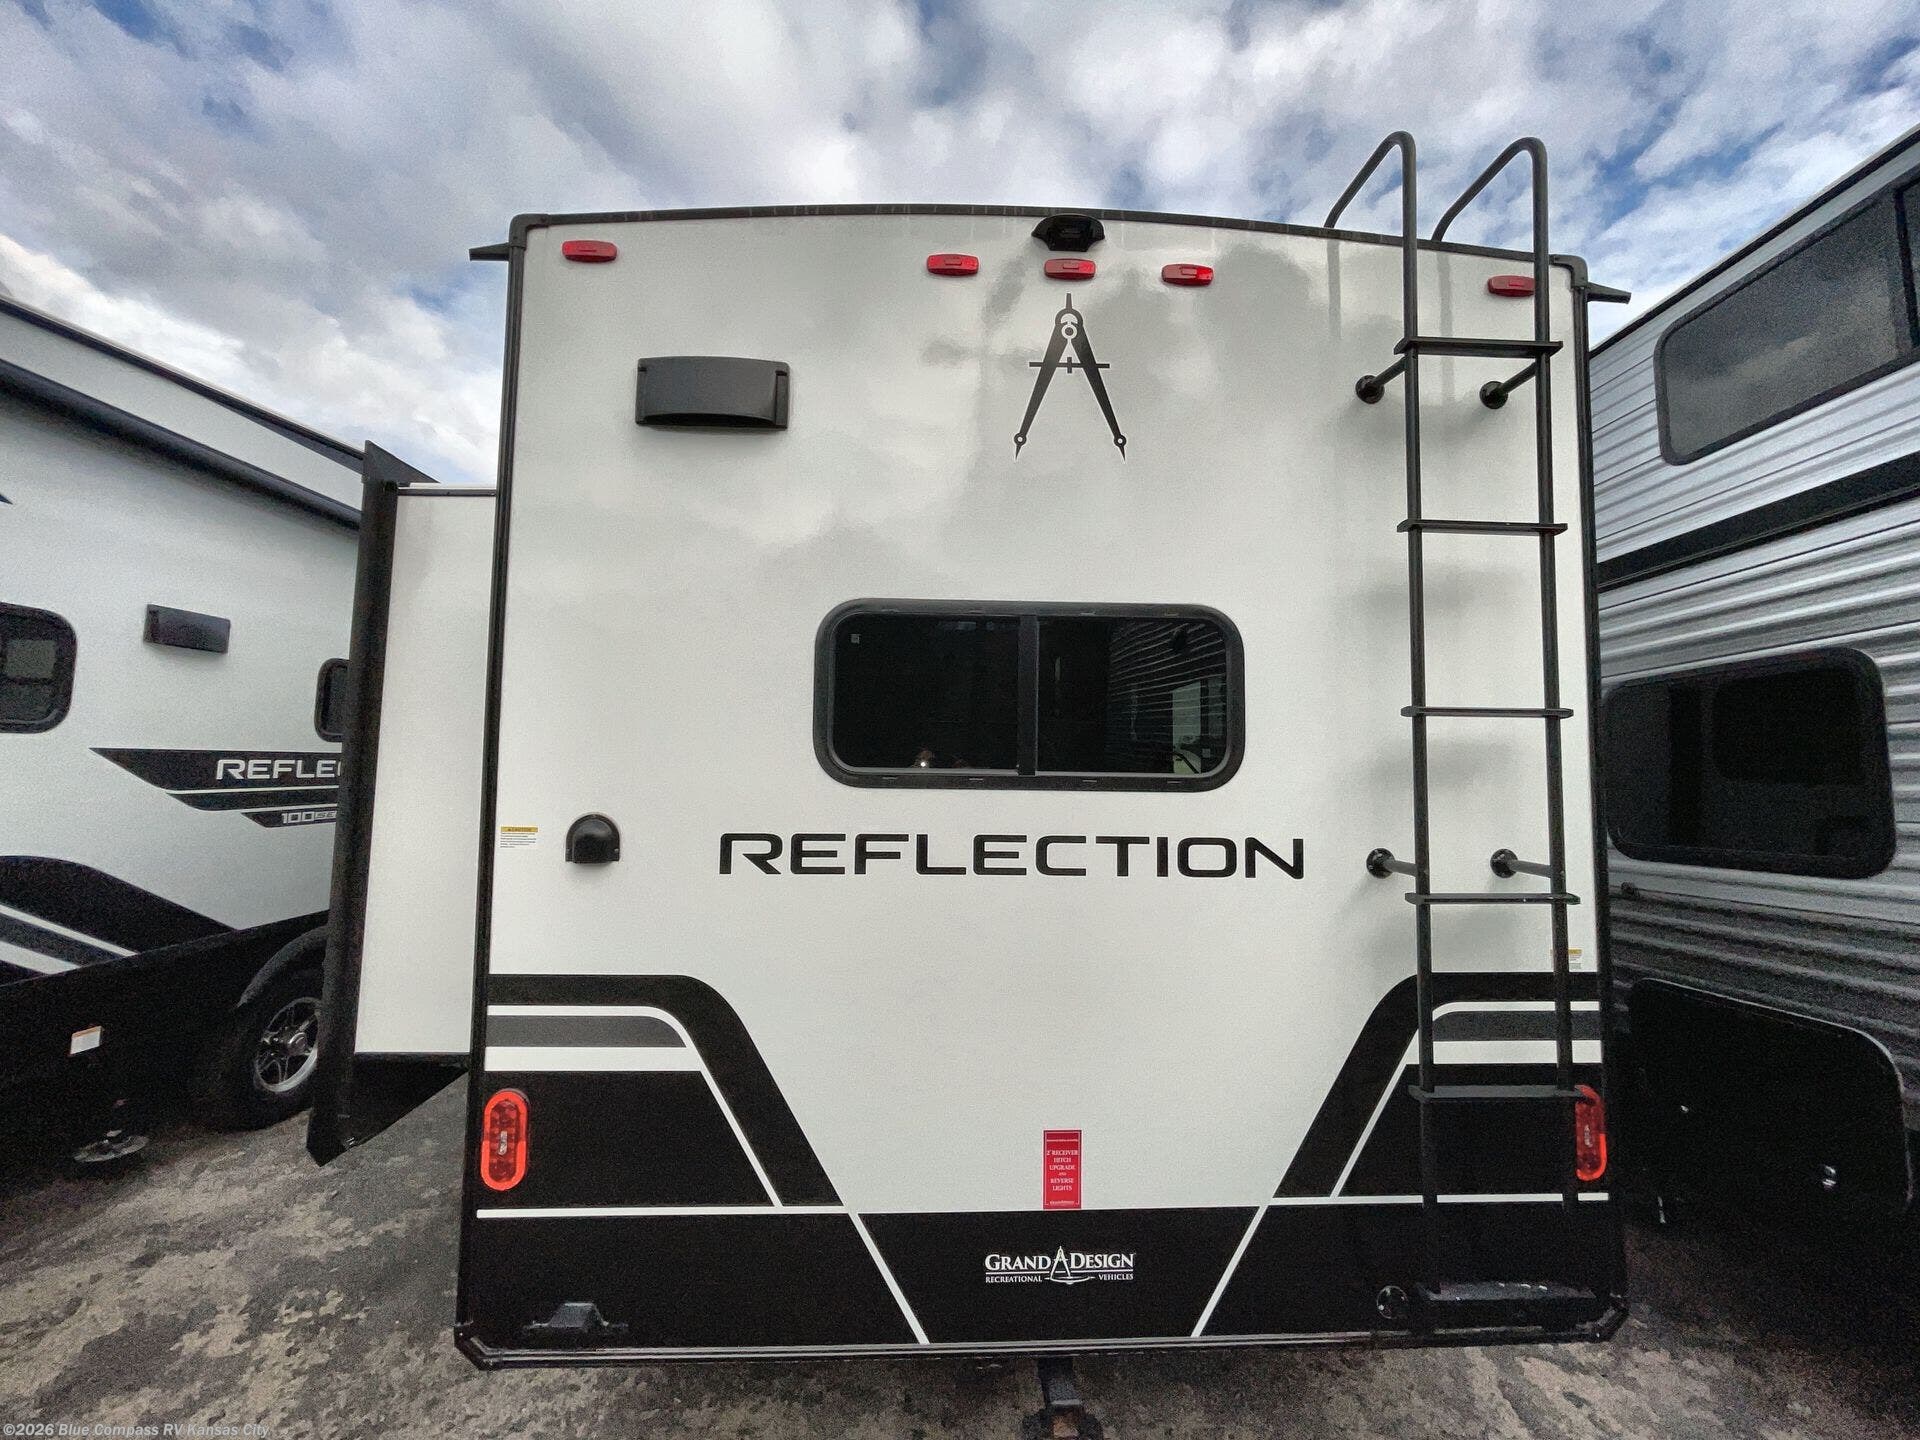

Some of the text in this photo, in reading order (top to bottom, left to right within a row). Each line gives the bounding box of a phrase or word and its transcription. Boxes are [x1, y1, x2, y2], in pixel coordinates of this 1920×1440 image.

[216, 759, 342, 780] REFLE
[719, 832, 1305, 880] REFLECTION
[984, 1252, 1134, 1271] GRAND DESIGN
[985, 1273, 1134, 1283] RECREATIONAL VEHICLES
